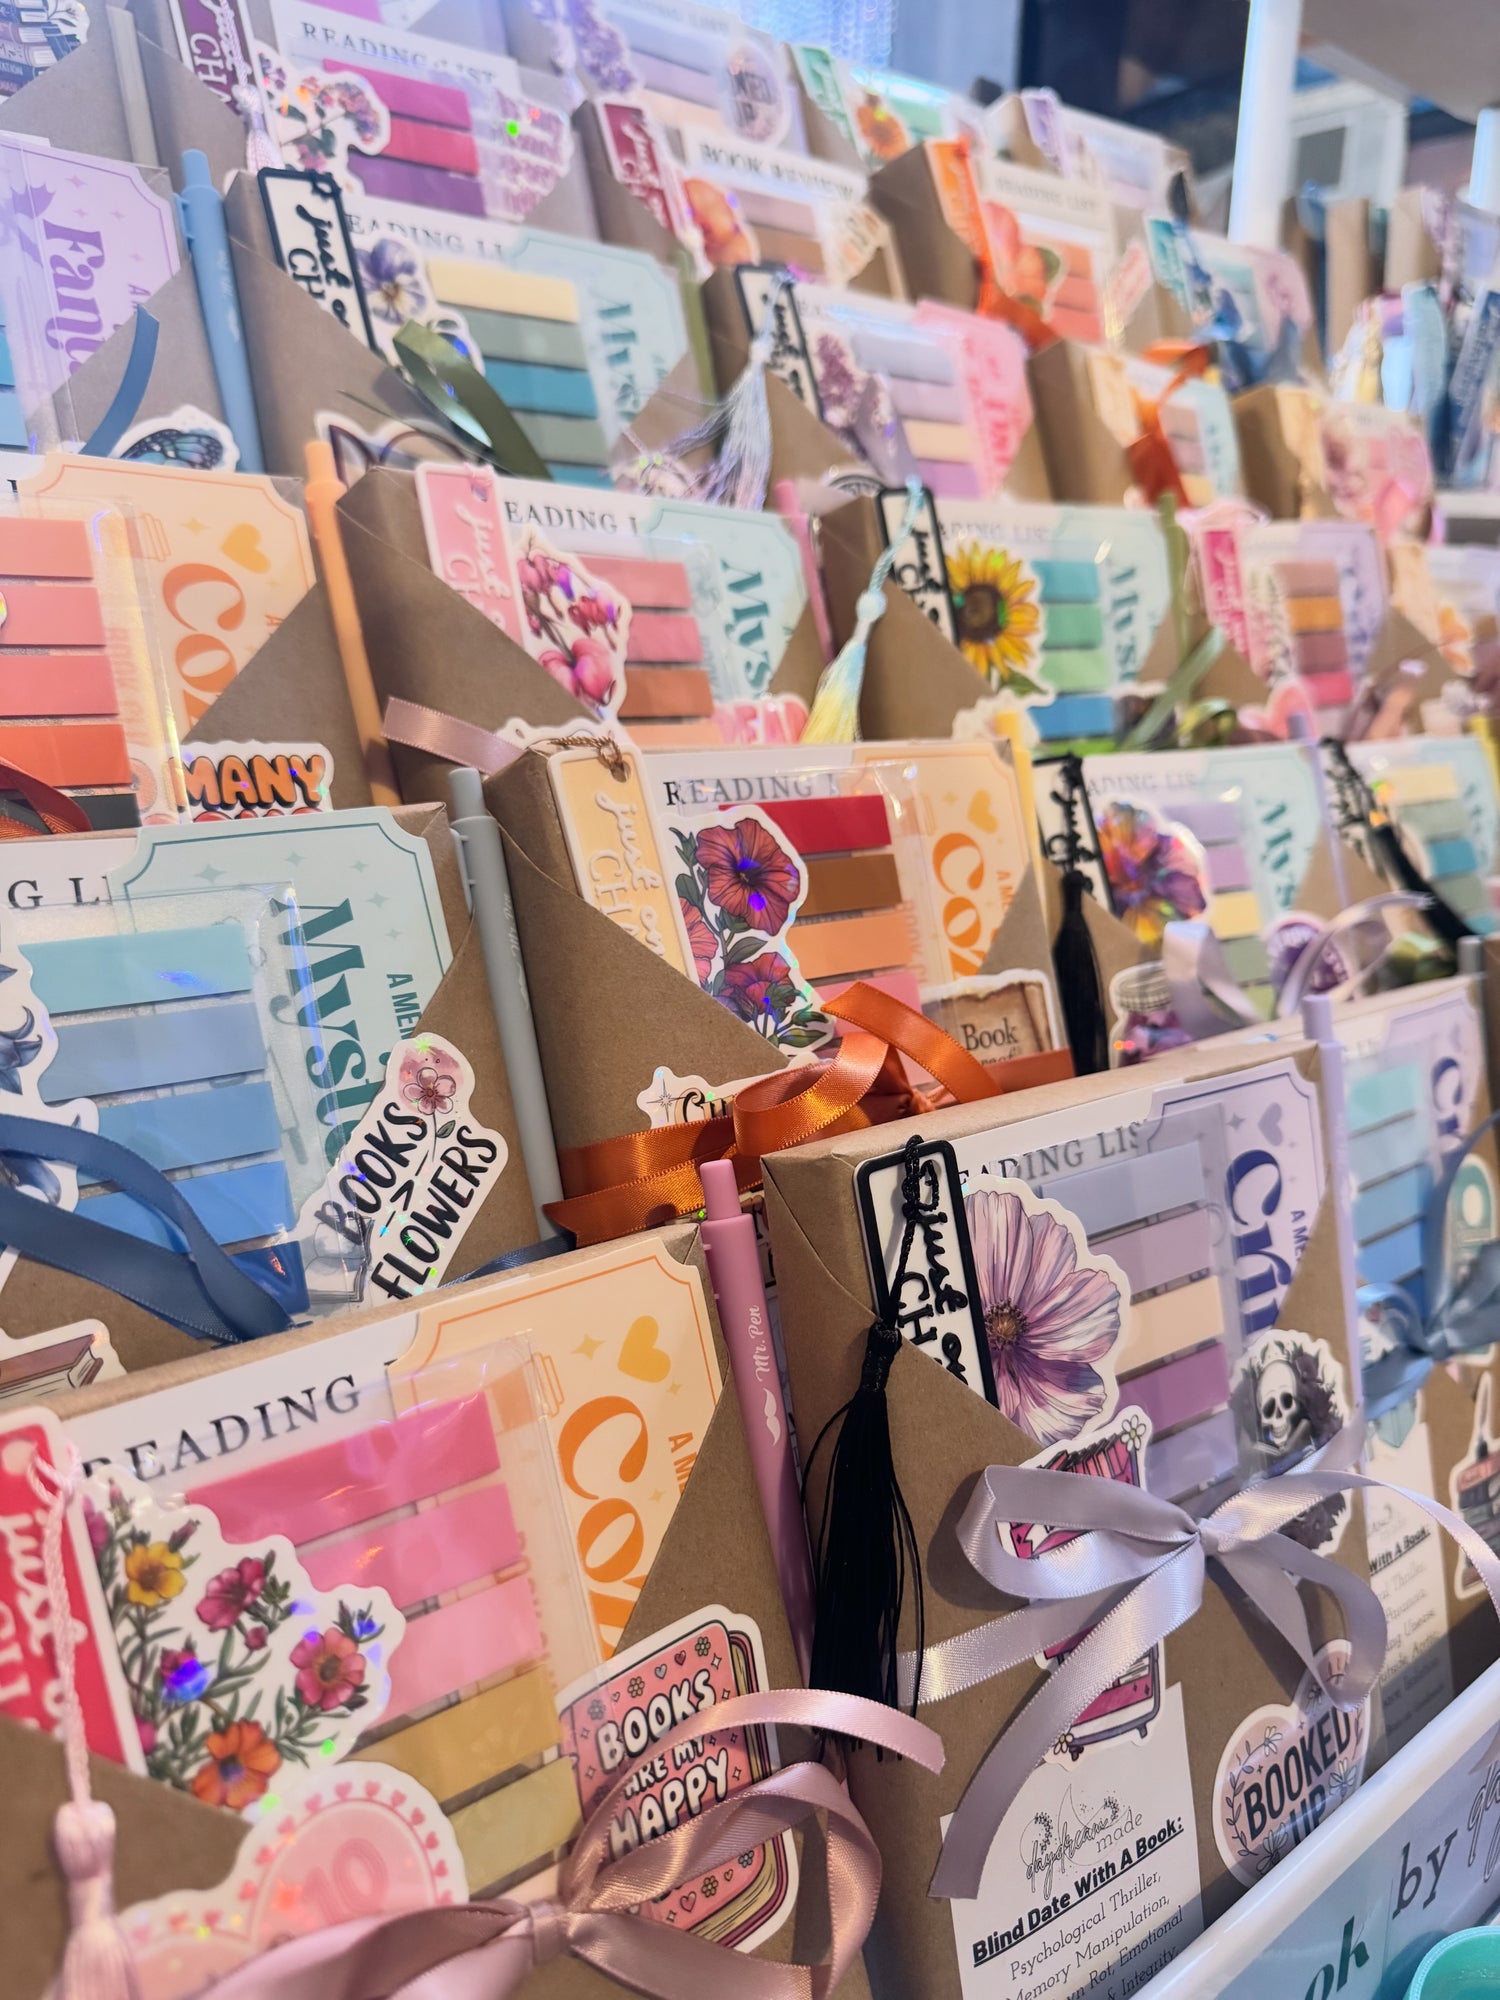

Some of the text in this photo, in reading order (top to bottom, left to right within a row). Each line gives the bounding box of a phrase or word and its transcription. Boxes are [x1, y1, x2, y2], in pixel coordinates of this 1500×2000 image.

[504, 501, 619, 534] EADING
[960, 1016, 1019, 1051] Book
[314, 1102, 428, 1246] BOOKS
[370, 1125, 499, 1299] FLOWERS
[959, 1140, 1084, 1190] EADING
[748, 1304, 765, 1339] Pen
[596, 1668, 717, 1773] BOOKS
[610, 1747, 729, 1862] HAPPY
[1243, 1706, 1351, 1842] BOOKED
[1096, 1806, 1143, 1853] made
[1391, 1828, 1459, 1921] by
[972, 1817, 1183, 1965] Blind Date With A Book:
[1010, 1871, 1162, 1981] Psychological Thriller,
[1006, 1894, 1171, 2000] Memory Manipulation,
[1089, 1963, 1116, 1991] Rot,
[1119, 1905, 1184, 1968] Emotional
[1304, 1915, 1371, 2000] ok
